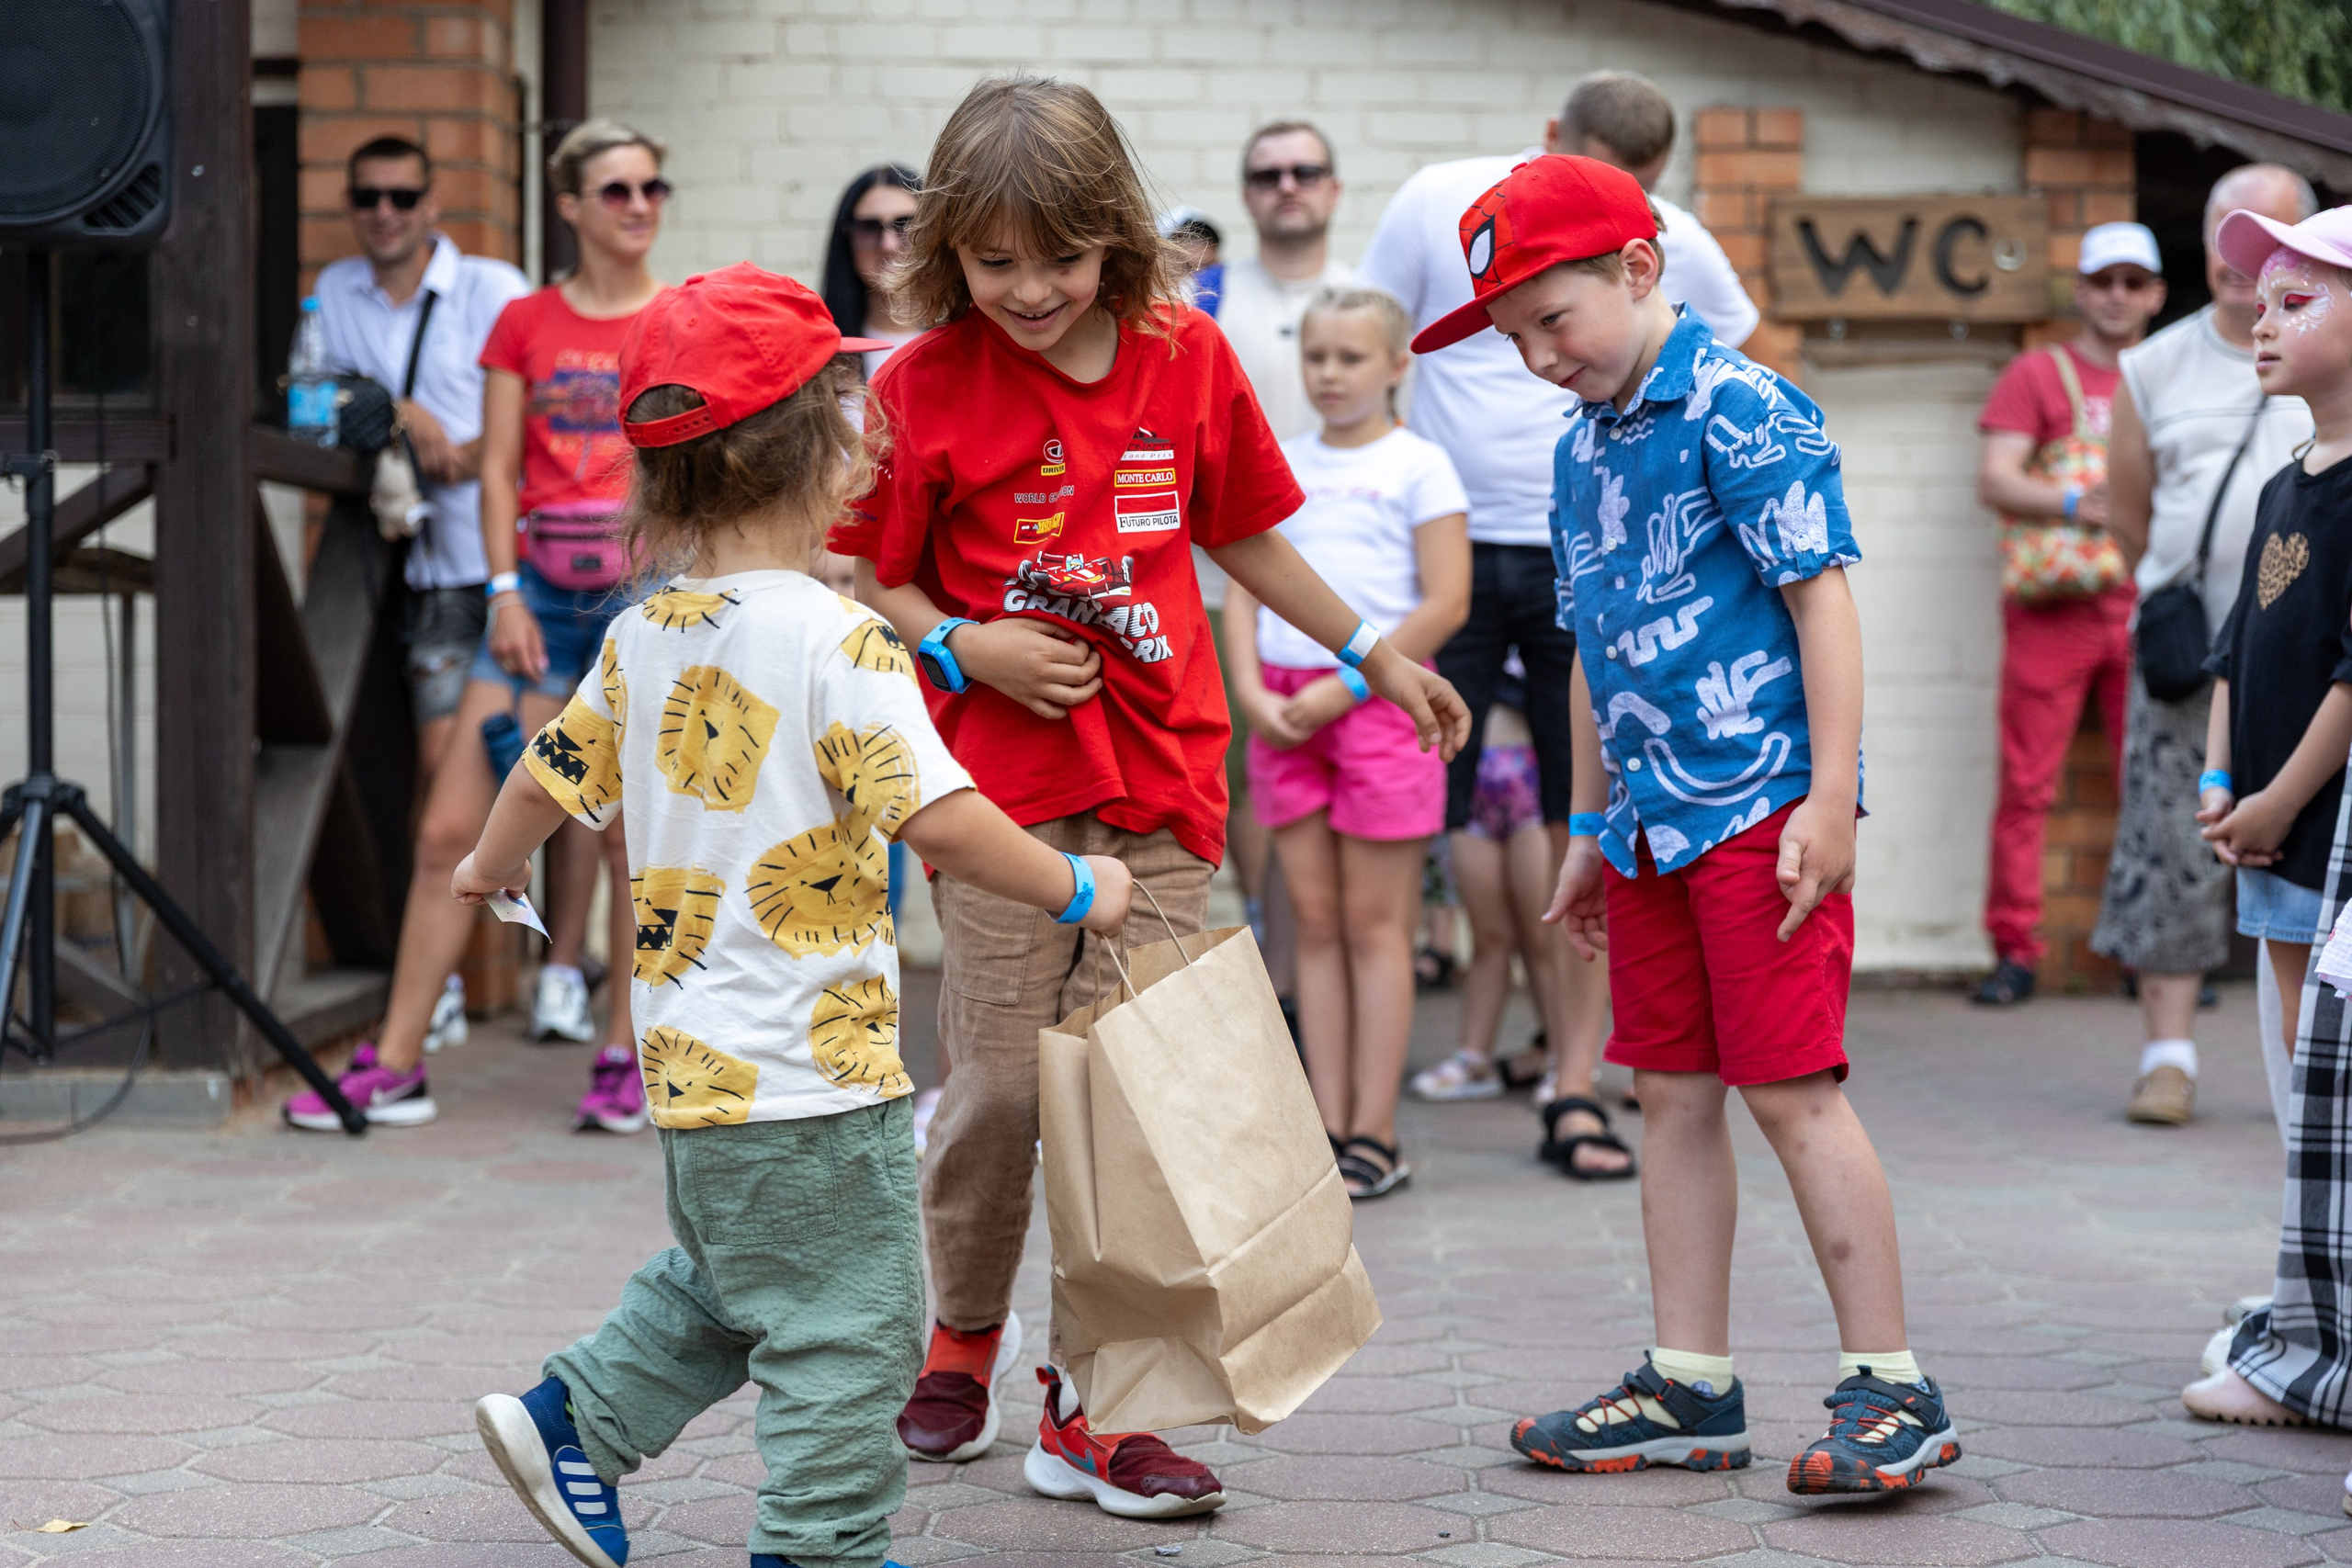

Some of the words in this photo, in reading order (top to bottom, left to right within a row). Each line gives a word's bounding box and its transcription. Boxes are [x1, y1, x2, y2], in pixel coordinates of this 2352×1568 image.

[1796, 212, 1990, 300] WC
[1125, 443, 1174, 451] ONACO
[1042, 465, 1065, 474] DRIVER
[1117, 473, 1144, 484] MONTE
[1145, 471, 1173, 483] CARLO
[1013, 492, 1046, 504] WORLD
[1152, 515, 1179, 526] PILOTA
